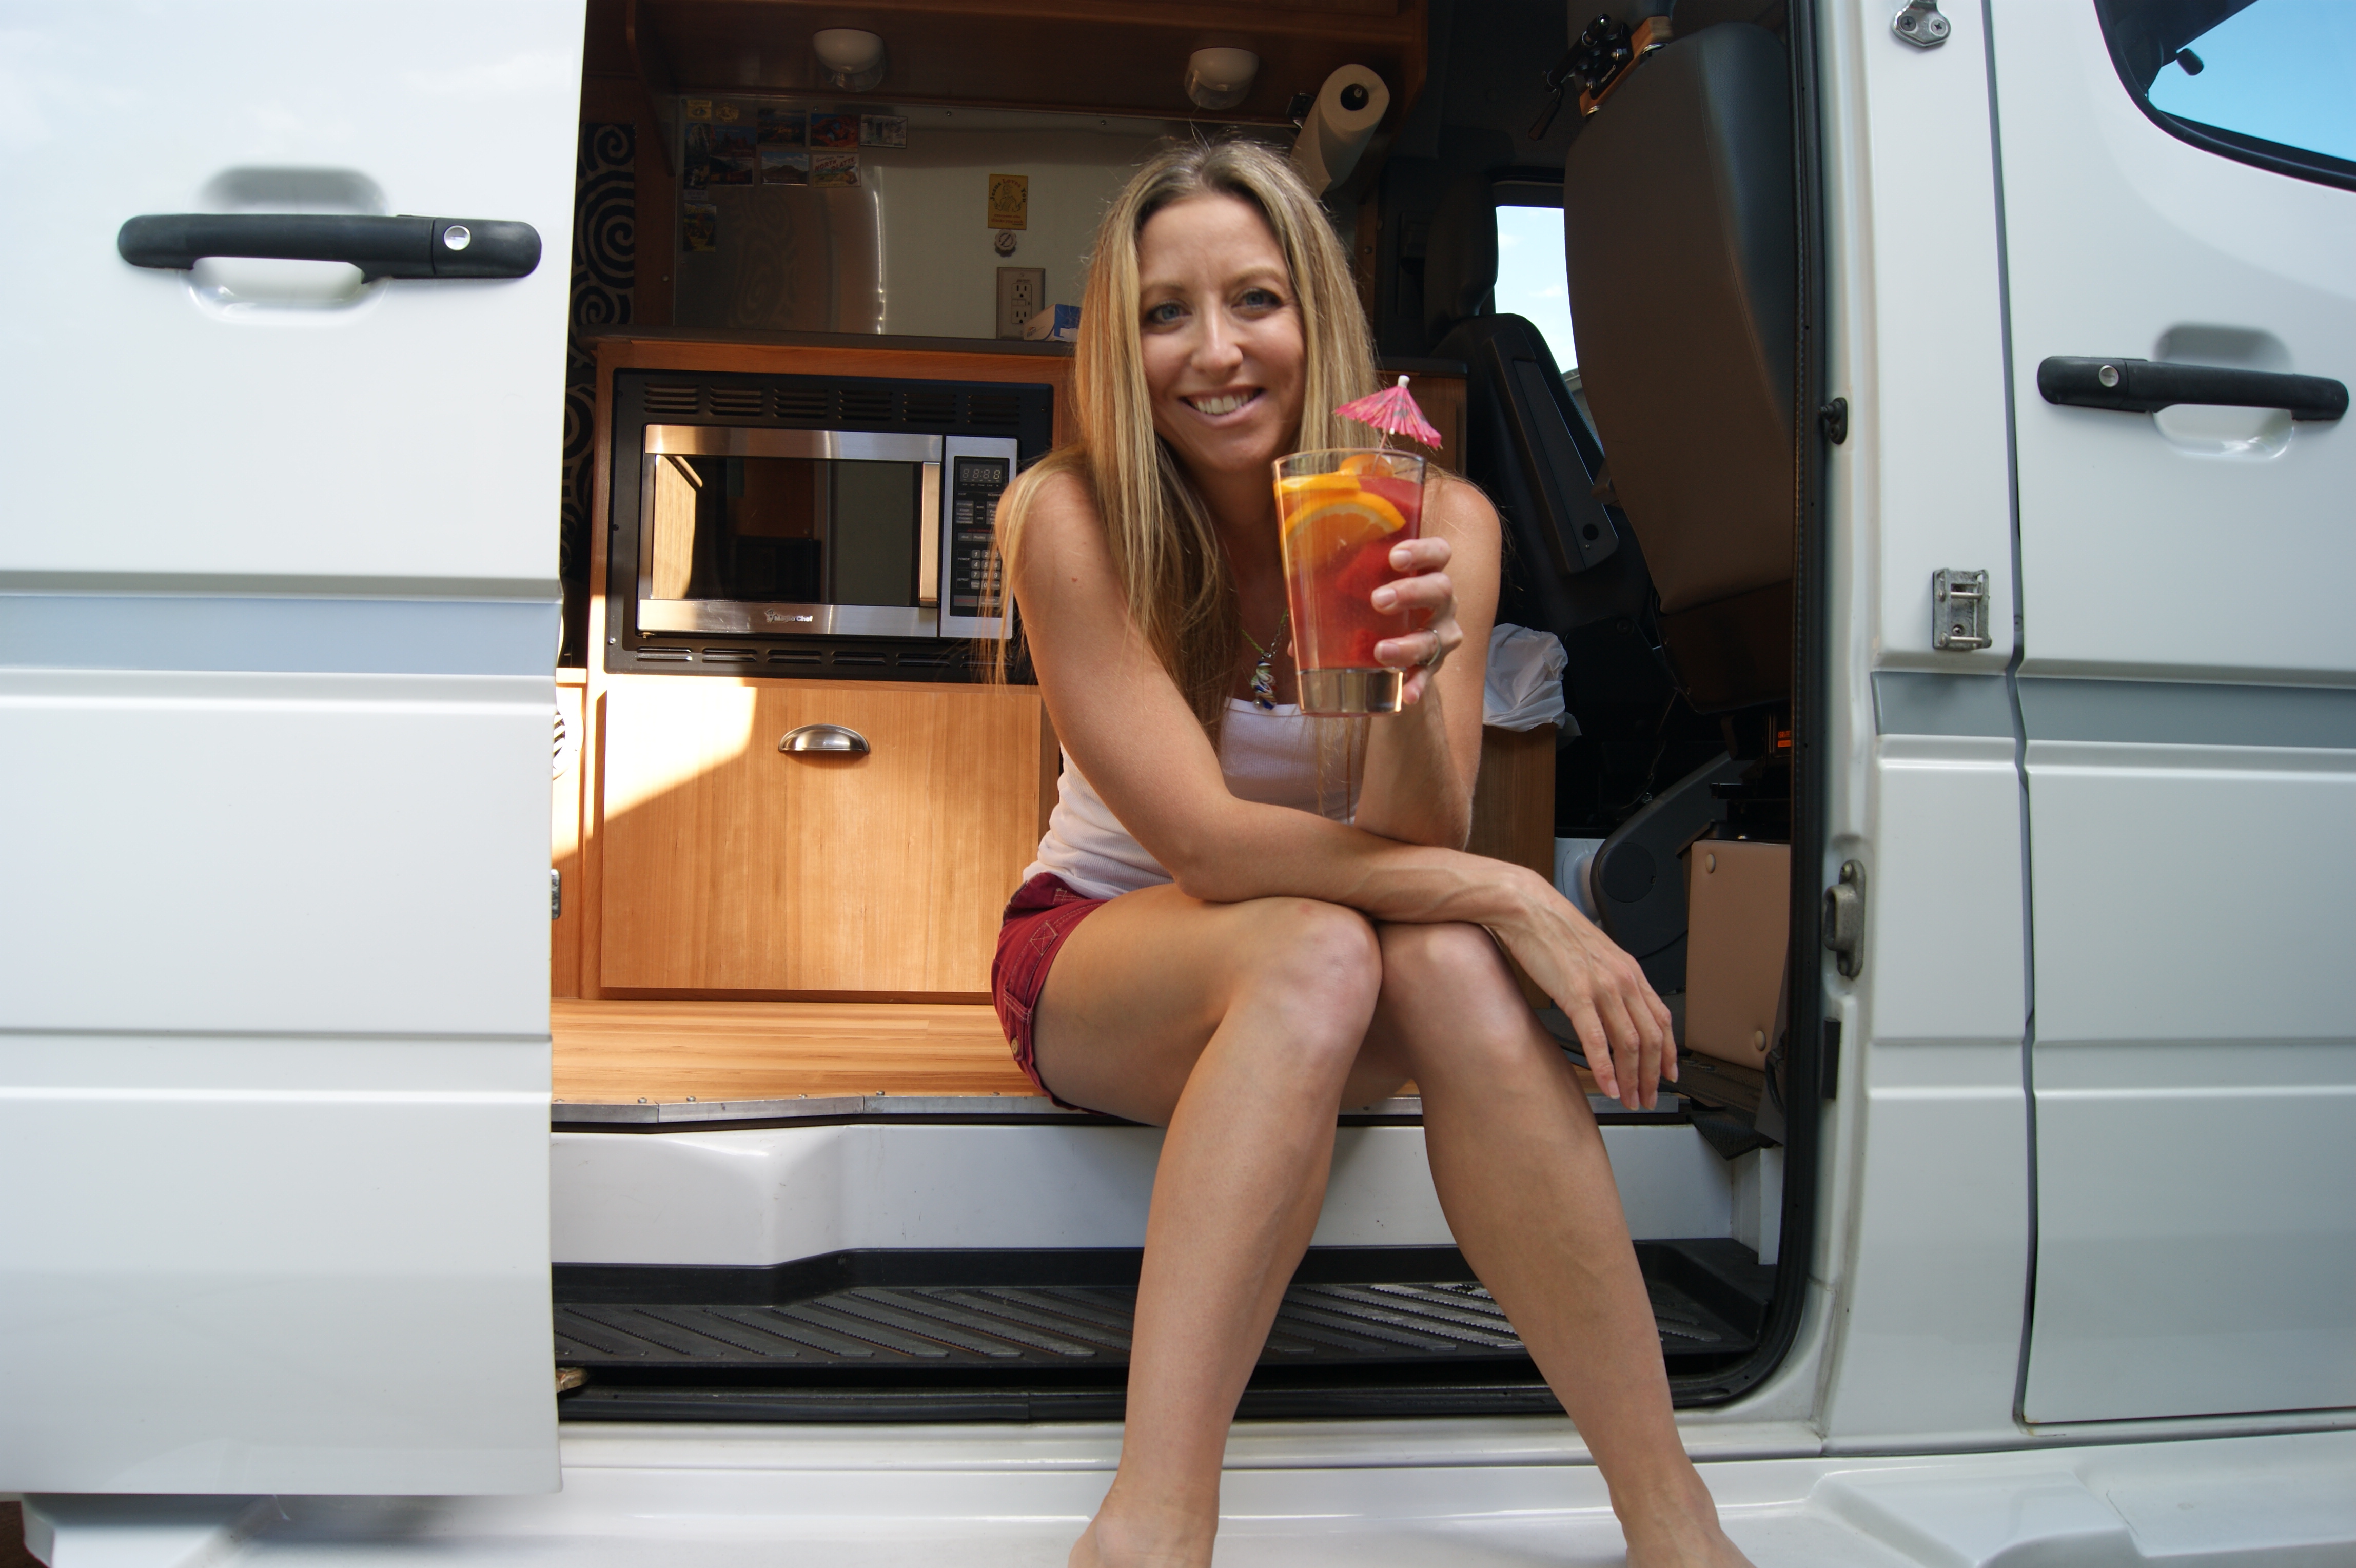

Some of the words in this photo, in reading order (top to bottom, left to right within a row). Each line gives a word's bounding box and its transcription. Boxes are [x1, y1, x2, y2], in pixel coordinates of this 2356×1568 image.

[815, 160, 837, 173] NORTH
[831, 156, 855, 174] PLATTE
[990, 182, 1002, 201] Jesus
[1002, 178, 1021, 188] Loves
